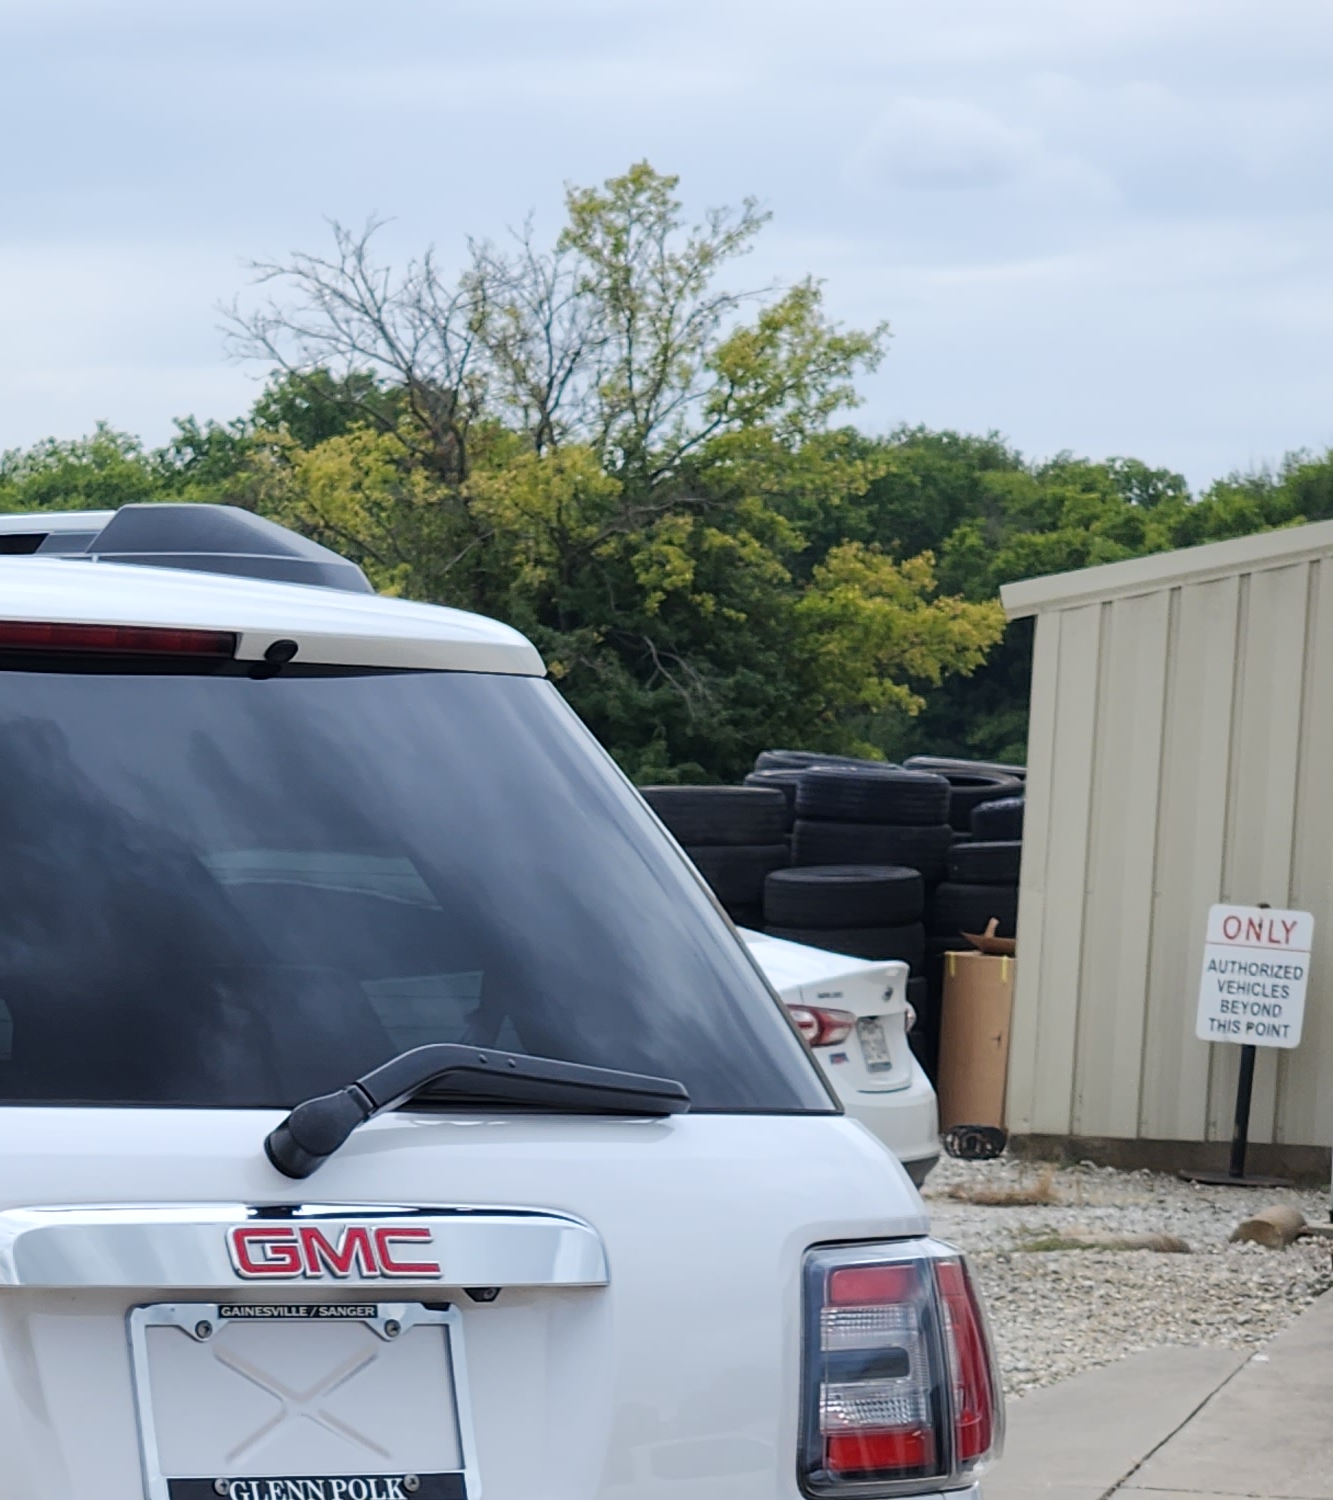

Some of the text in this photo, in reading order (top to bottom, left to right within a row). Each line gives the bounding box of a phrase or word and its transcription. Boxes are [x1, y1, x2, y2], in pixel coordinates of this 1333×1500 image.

[1222, 915, 1298, 945] ONLY
[1207, 958, 1304, 981] AUTHORIZED
[1217, 979, 1290, 999] VEHICLES
[1220, 999, 1282, 1018] BEYOND
[1208, 1017, 1291, 1038] THIS POINT
[228, 1224, 443, 1280] GMC
